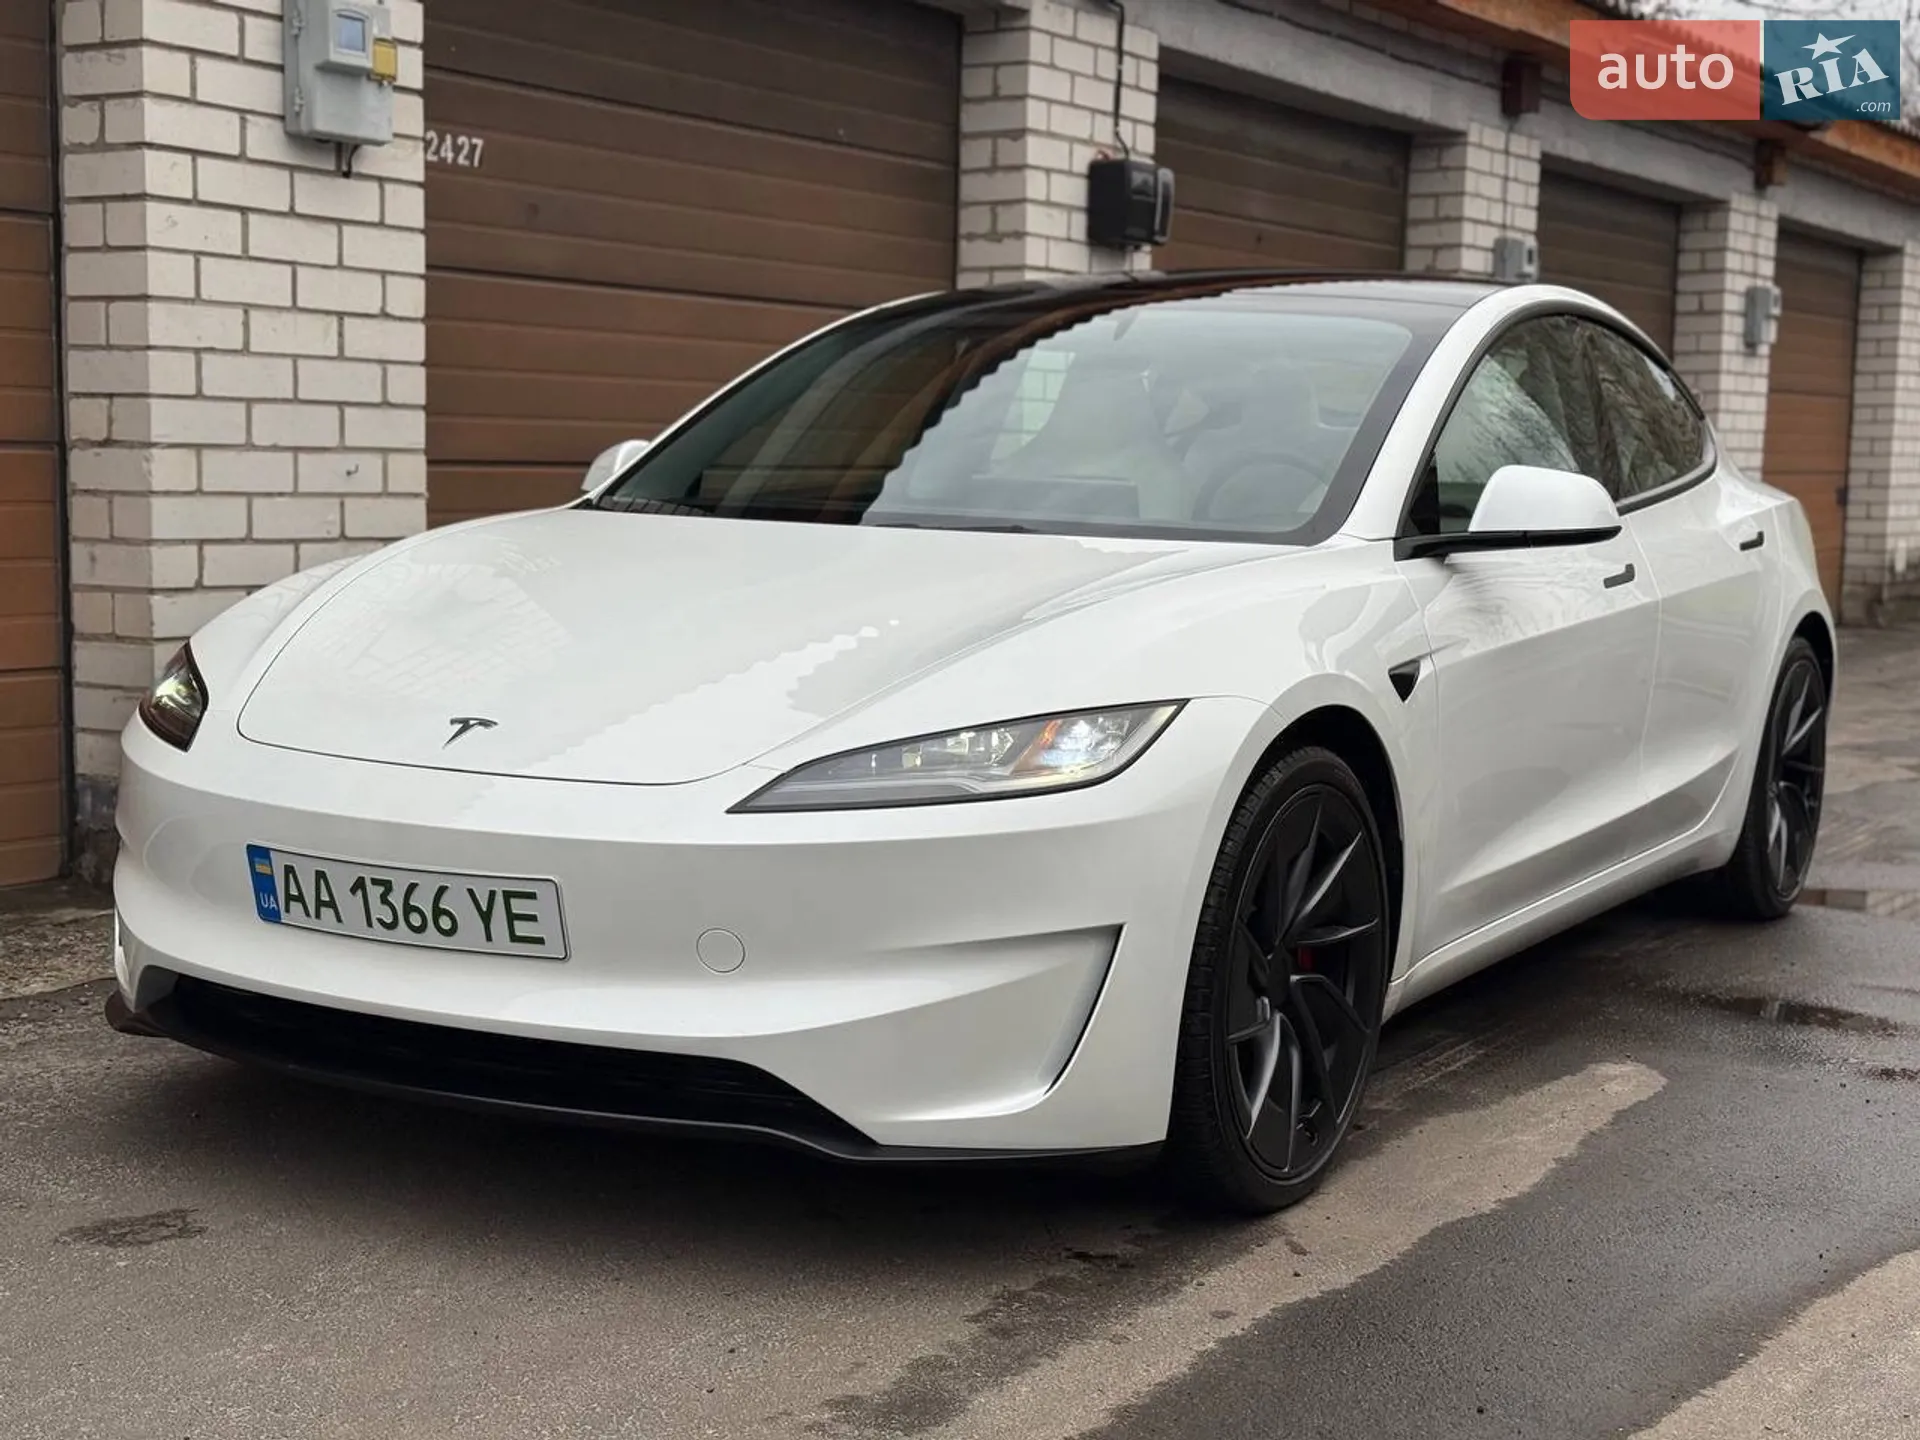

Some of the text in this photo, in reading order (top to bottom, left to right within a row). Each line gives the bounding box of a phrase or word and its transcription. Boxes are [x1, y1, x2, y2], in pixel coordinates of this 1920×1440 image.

[425, 130, 483, 167] 2427
[260, 892, 278, 911] UA
[284, 864, 545, 945] AA 1366 YE
